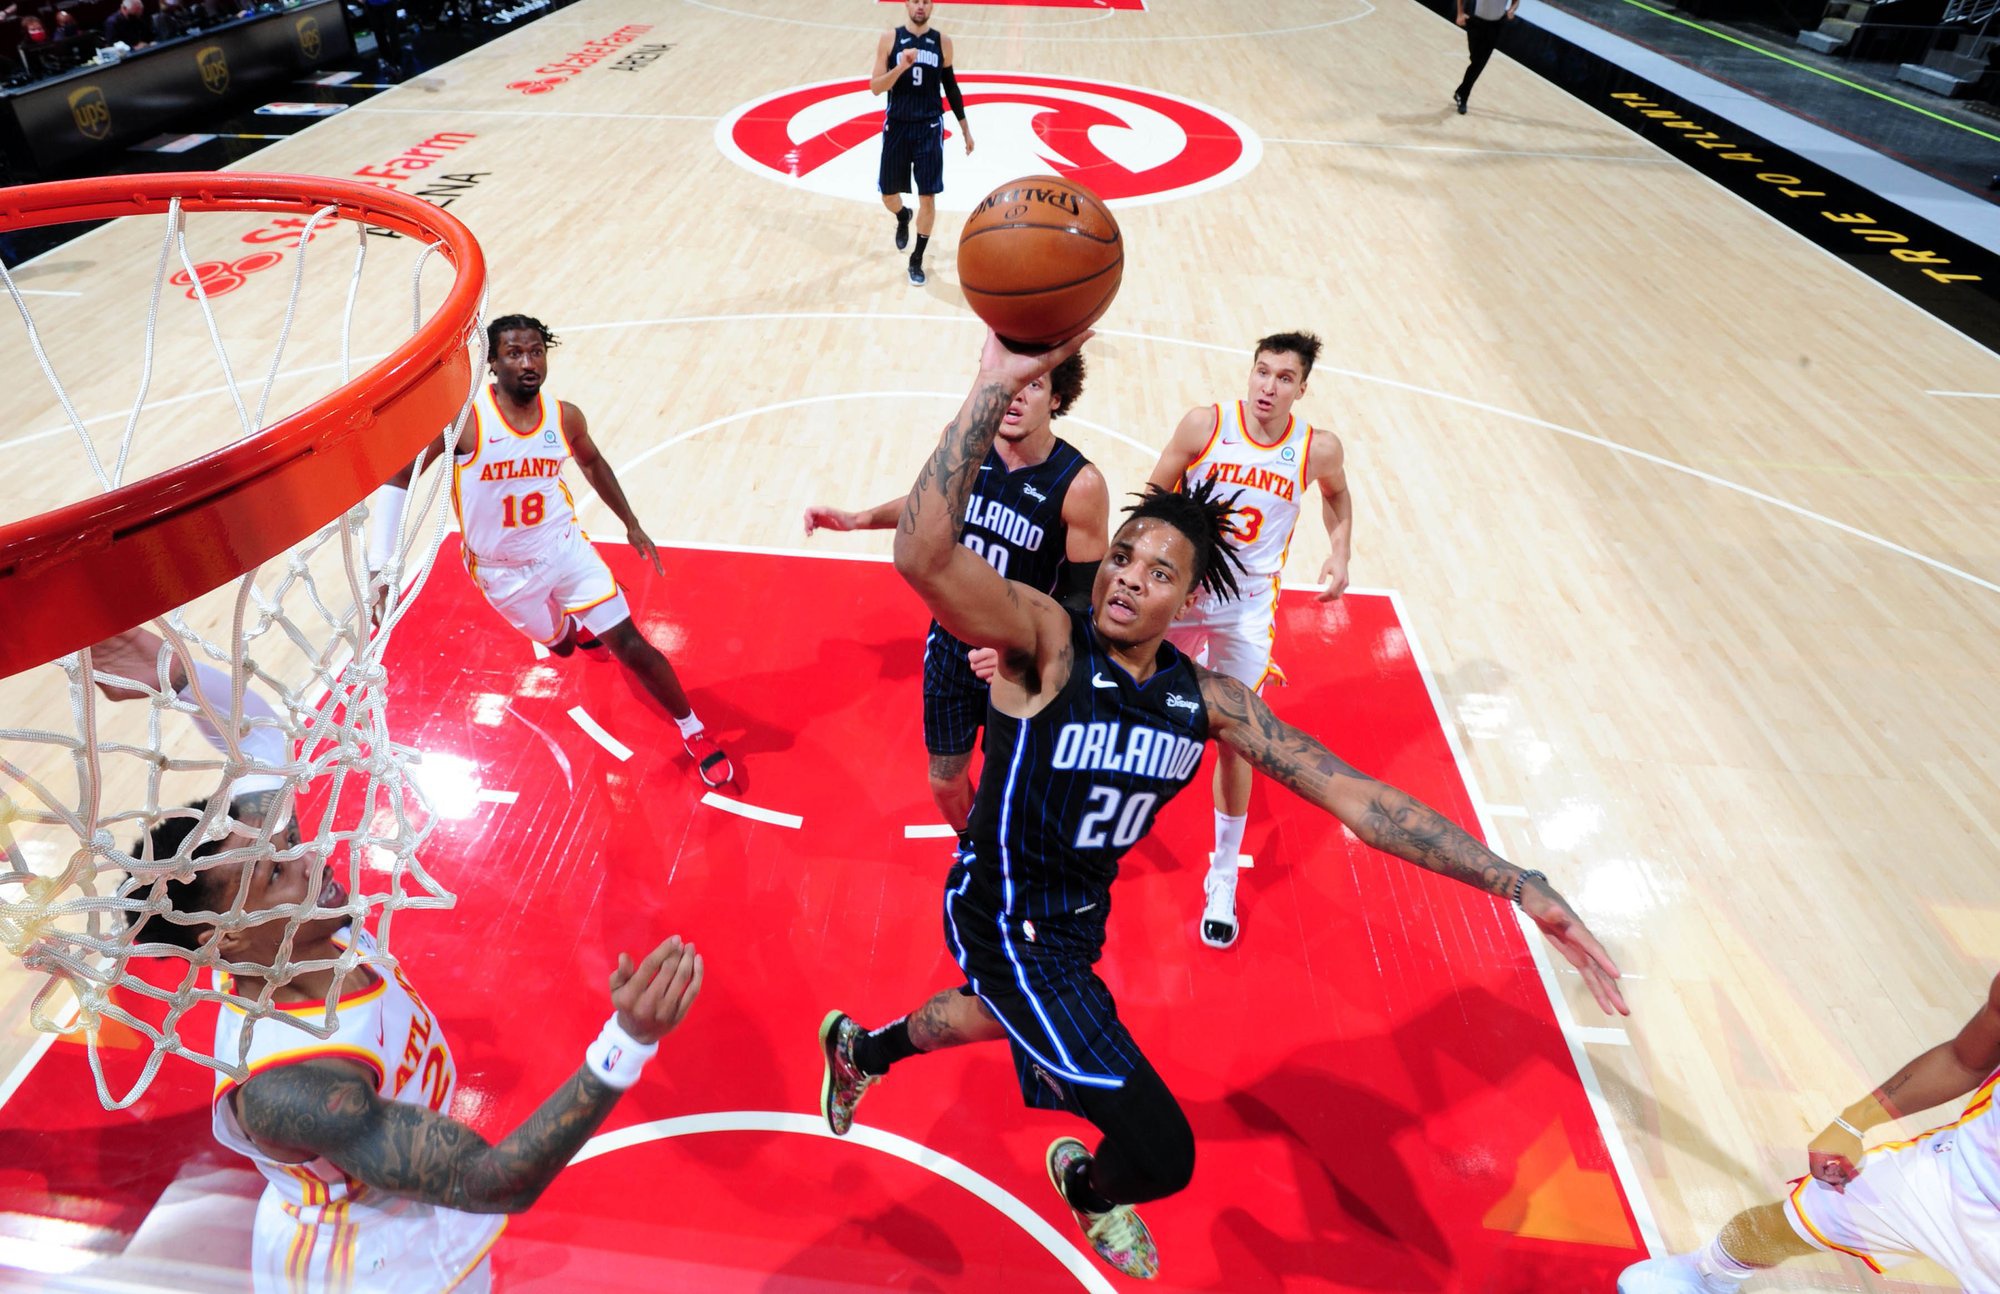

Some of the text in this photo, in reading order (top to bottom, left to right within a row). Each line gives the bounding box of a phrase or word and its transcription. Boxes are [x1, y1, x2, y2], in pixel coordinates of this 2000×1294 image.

[300, 29, 320, 51] ups
[608, 43, 677, 72] ARENA
[202, 59, 229, 87] ups
[912, 66, 923, 86] 9
[76, 97, 108, 132] ups
[1610, 92, 1983, 283] TRUE TO ATLANTA
[1205, 462, 1295, 503] ATLANTA
[502, 490, 546, 529] 18
[964, 494, 1044, 551] LANDO
[1165, 692, 1200, 713] Disney
[1051, 722, 1205, 781] ORLANDO
[1073, 785, 1158, 849] 20
